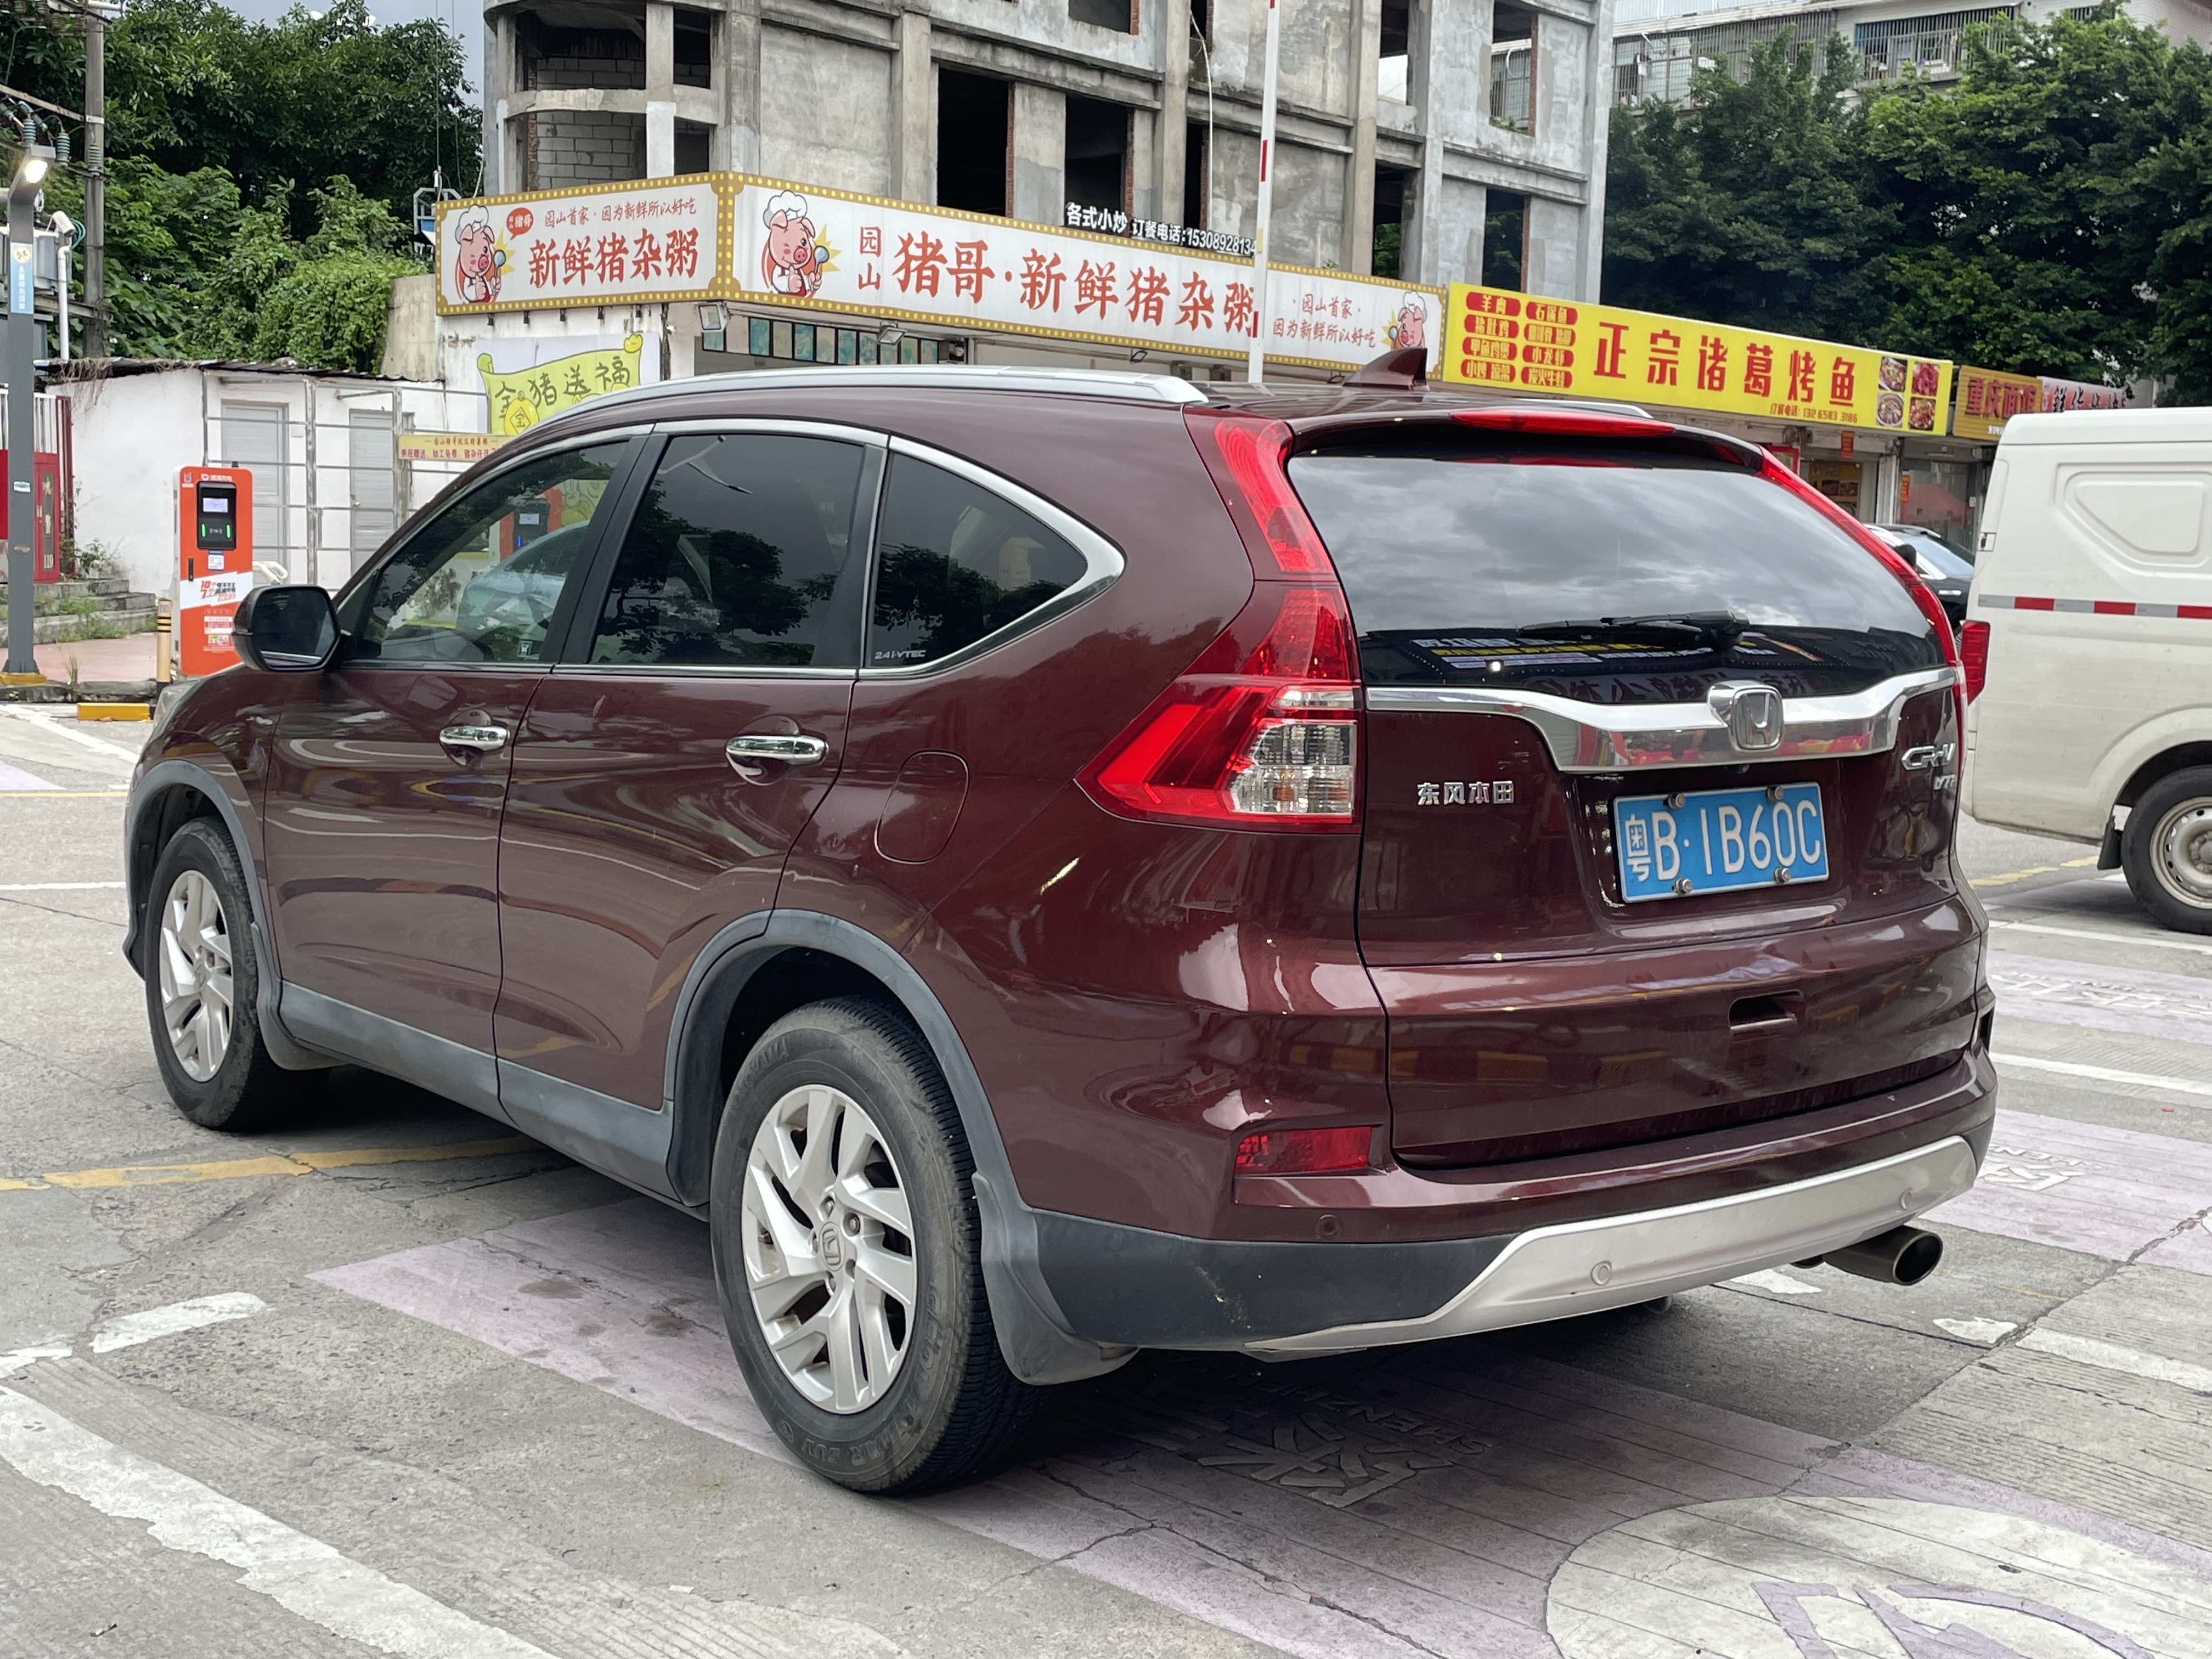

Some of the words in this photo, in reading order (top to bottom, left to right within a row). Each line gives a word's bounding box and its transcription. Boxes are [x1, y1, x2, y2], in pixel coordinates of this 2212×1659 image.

[1066, 202, 1128, 233] 各式小炒
[528, 227, 699, 289] 新鲜猪杂粥
[858, 226, 882, 290] 园山
[1481, 294, 1506, 315] 羊肉
[1273, 317, 1376, 348] 因为新鲜所以好吃
[1532, 346, 1565, 366] 小龙虾
[1594, 321, 1856, 407] 正宗诸葛烤鱼
[43, 554, 54, 569] 119
[1417, 781, 1514, 805] 东风本田
[1625, 799, 1821, 882] 粤B·1B60C
